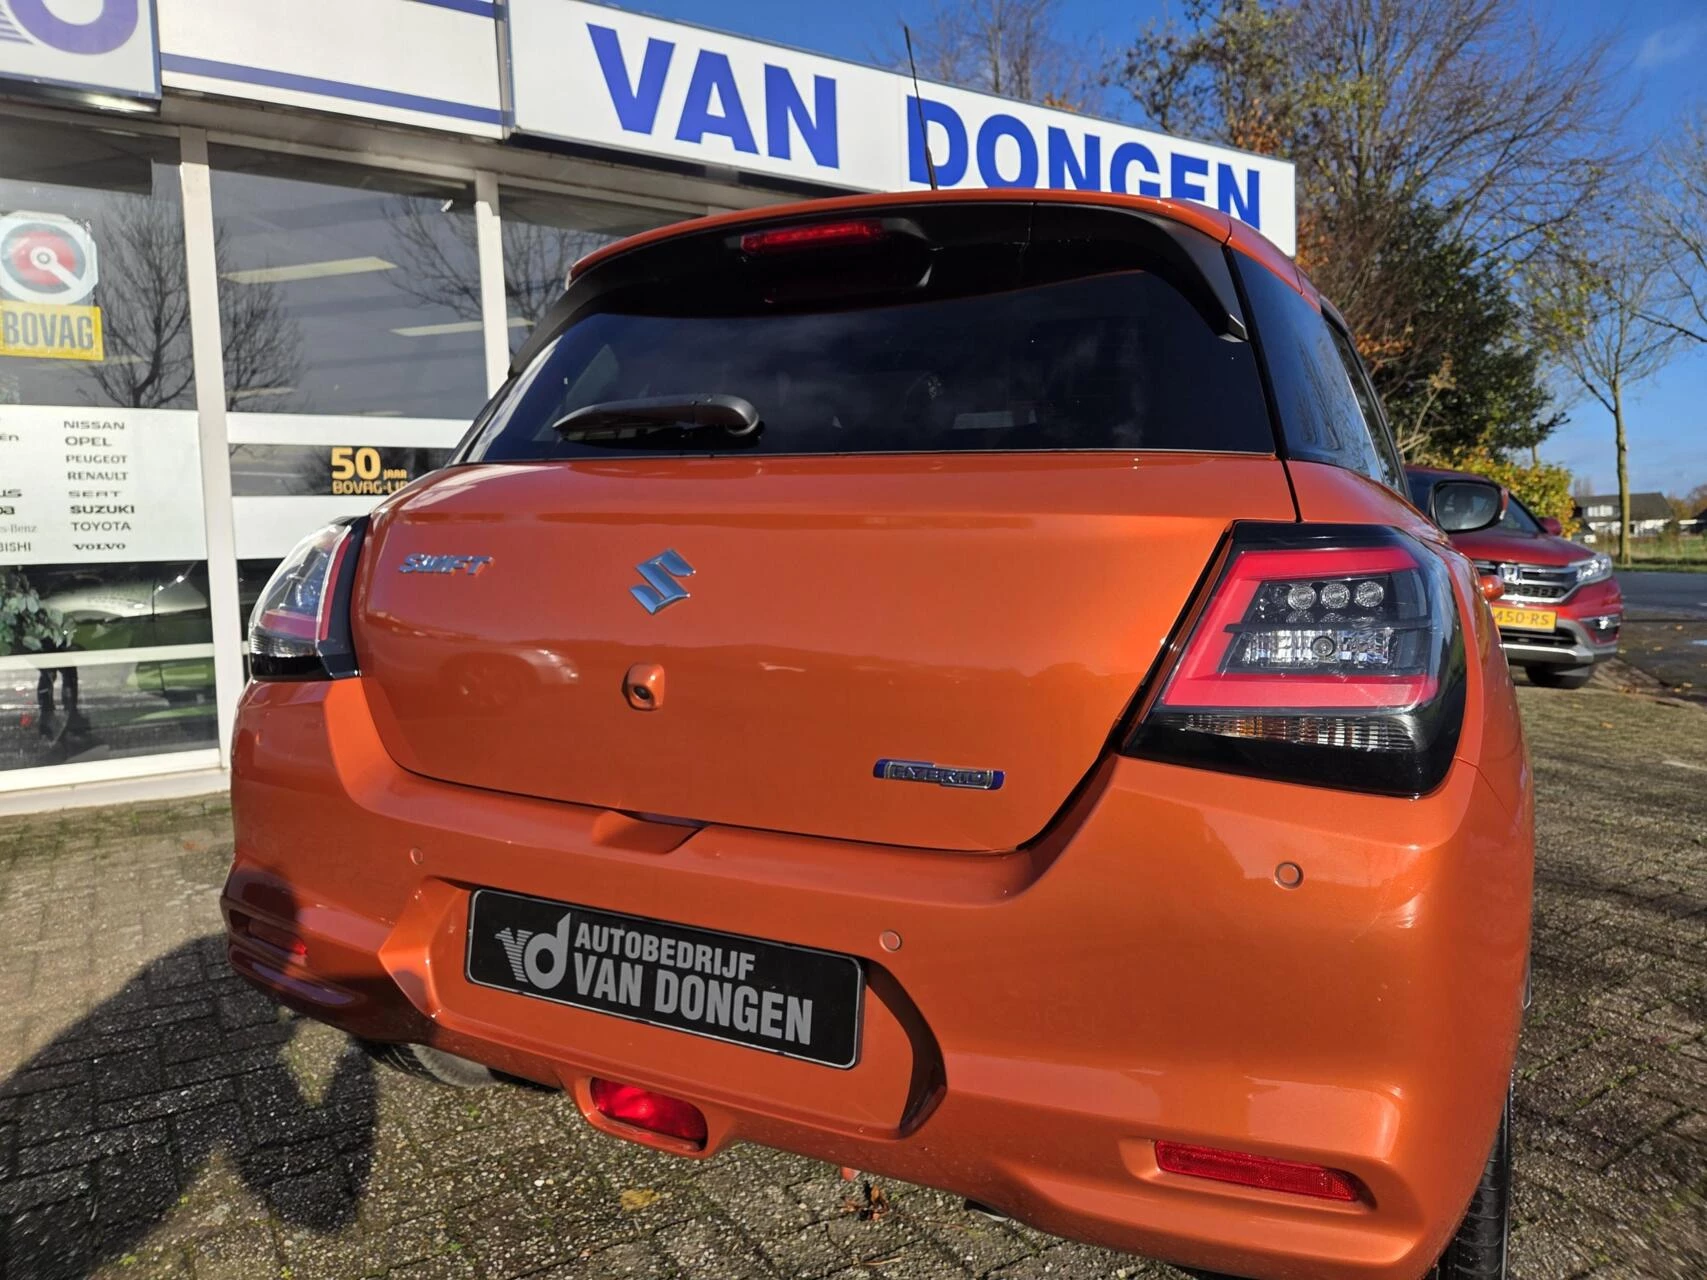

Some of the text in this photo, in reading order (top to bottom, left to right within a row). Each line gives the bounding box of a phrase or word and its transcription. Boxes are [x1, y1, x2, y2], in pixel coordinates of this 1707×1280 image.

[586, 22, 1261, 232] VAN DONGEN
[2, 311, 94, 349] BOVAG
[63, 420, 125, 430] NISSAN
[65, 436, 112, 447] OPEL
[65, 454, 128, 464] PEUGEOT
[331, 447, 381, 480] 50
[67, 471, 129, 481] RENAULT
[68, 490, 123, 498] SEAT
[70, 504, 135, 515] SUZUKI
[71, 521, 132, 531] TOYOTA
[73, 542, 126, 551] VOLVO
[399, 553, 494, 576] SWIFT
[574, 922, 756, 981] AUTOBEDRIJF
[574, 951, 813, 1046] VAN DONGEN
